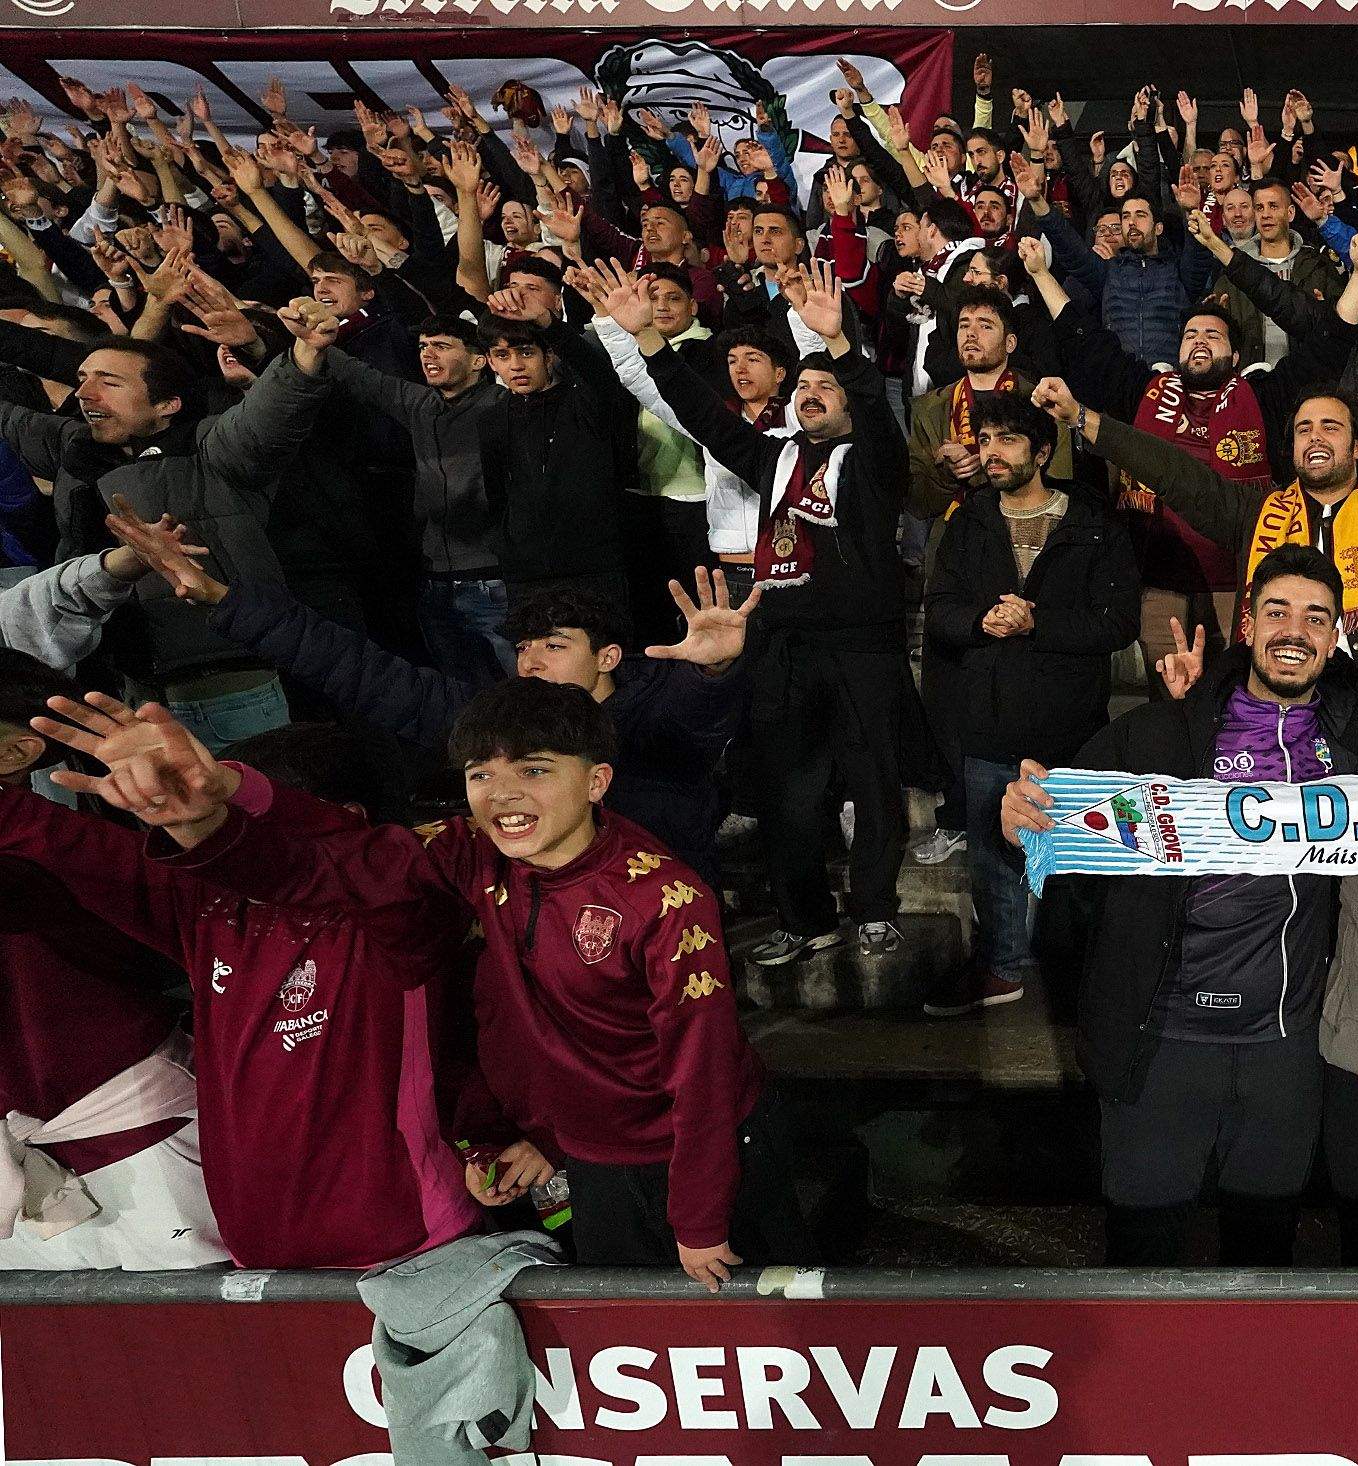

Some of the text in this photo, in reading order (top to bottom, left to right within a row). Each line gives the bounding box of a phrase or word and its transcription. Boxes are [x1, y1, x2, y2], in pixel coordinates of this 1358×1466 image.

[1150, 783, 1184, 864] C.D. GROVE
[1296, 845, 1358, 868] Máis
[342, 1345, 1059, 1432] CNSERVAS
